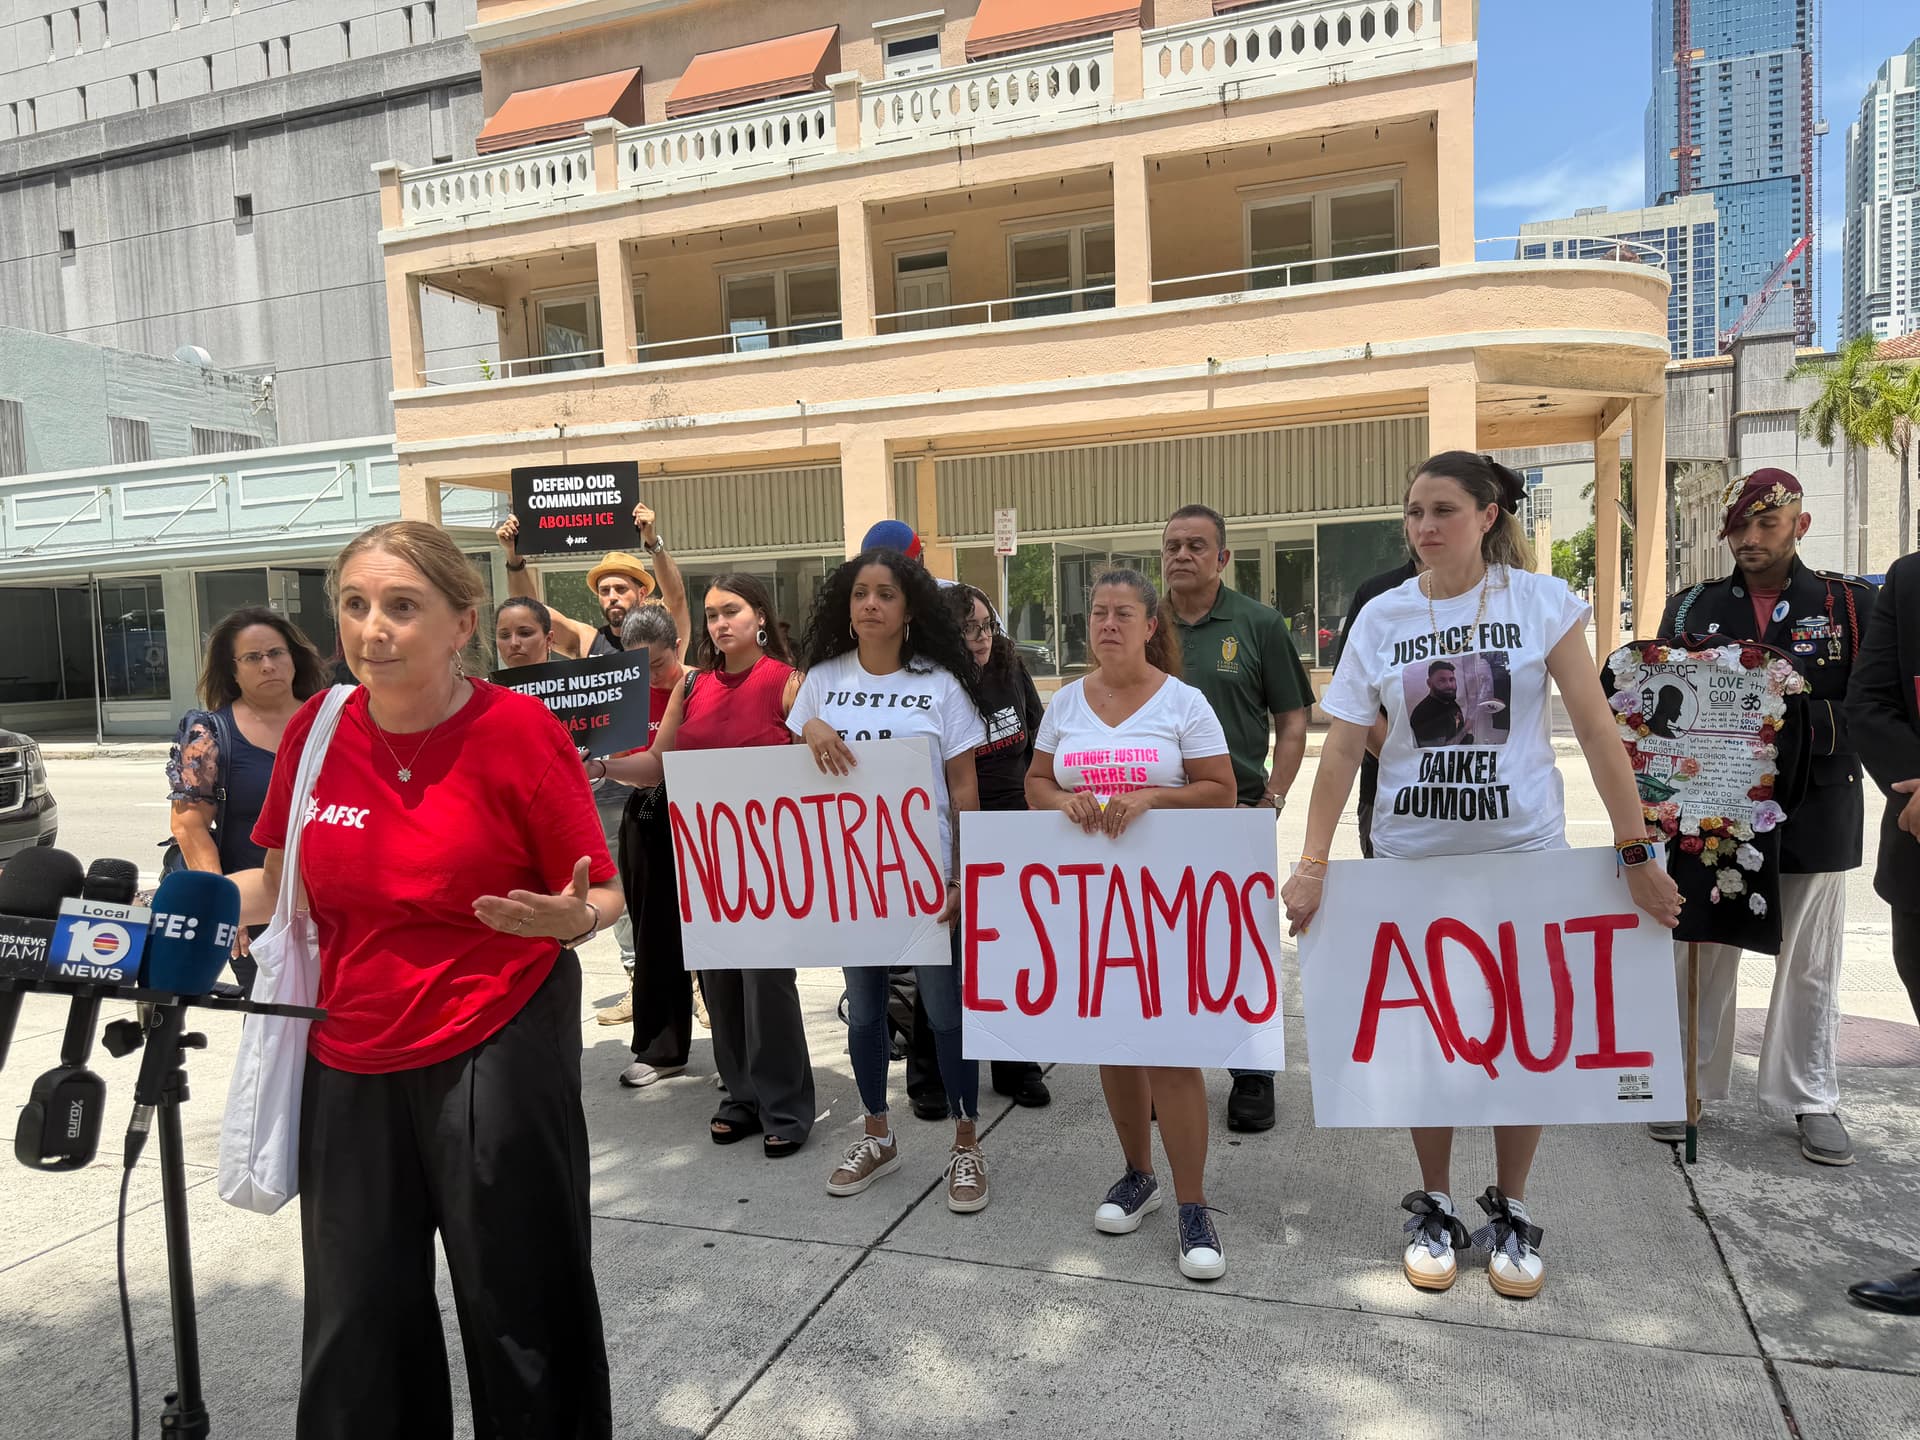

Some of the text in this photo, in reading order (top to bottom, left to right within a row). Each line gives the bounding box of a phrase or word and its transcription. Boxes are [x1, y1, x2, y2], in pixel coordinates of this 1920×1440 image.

[533, 474, 616, 492] DEFEND OUR
[528, 490, 622, 509] COMMUNITIES
[539, 512, 615, 529] ABOLISH ICE
[1390, 622, 1522, 668] JUSTICE FOR
[509, 666, 641, 696] FIENDE NUESTRAS
[1639, 664, 1698, 692] STOP ICE
[1709, 676, 1744, 690] LOVE
[825, 691, 932, 710] JUSTICE
[1709, 690, 1736, 703] GOD
[590, 713, 610, 728] ICE
[1064, 748, 1159, 767] WITHOUT JUSTICE
[1081, 766, 1147, 785] THERE IS
[1393, 784, 1511, 822] DUMONT
[318, 804, 370, 829] AFSC
[669, 787, 945, 922] NOSOTRAS
[82, 905, 130, 919] Local
[152, 913, 198, 940] FE:
[214, 922, 238, 948] EF
[16, 936, 47, 947] NEWS
[67, 920, 130, 966] 10
[962, 862, 1277, 1024] ESTAMOS
[0, 943, 46, 961] IAMI
[60, 963, 123, 981] NEWS
[1352, 913, 1654, 1080] AQUI
[68, 1100, 83, 1138] auray
